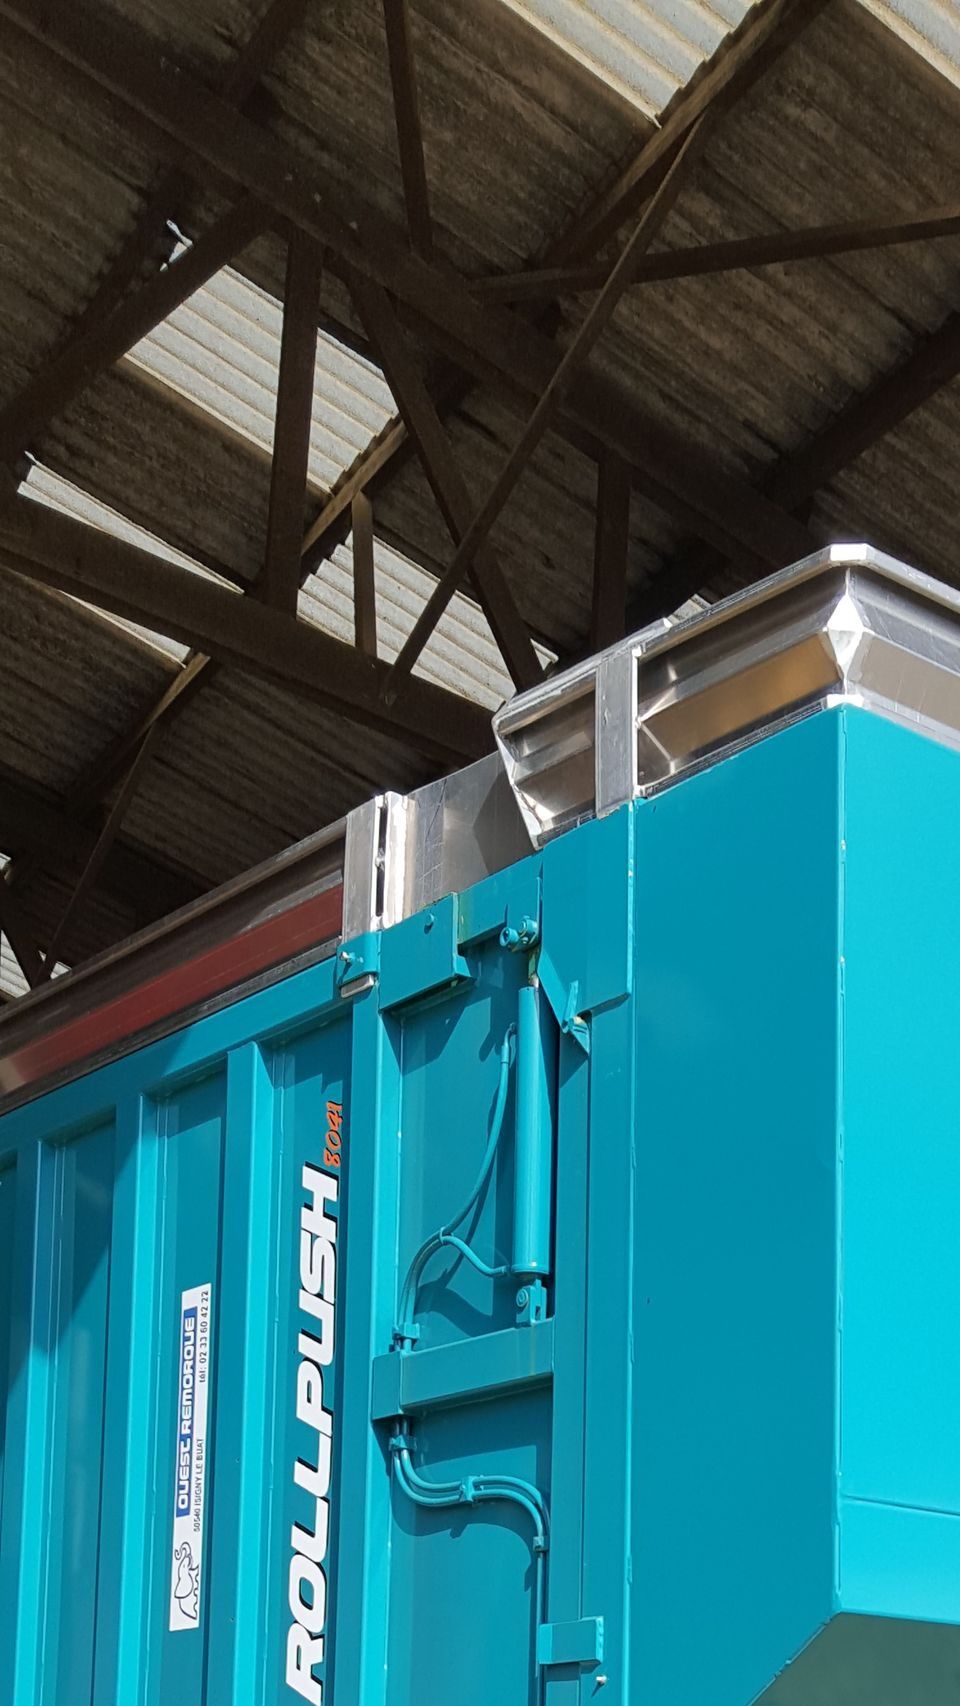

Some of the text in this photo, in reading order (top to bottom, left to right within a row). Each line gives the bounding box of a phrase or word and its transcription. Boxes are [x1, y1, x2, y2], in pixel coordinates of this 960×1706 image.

[323, 1100, 343, 1168] 8041
[200, 1291, 209, 1303] 22
[200, 1306, 209, 1318] 42
[199, 1321, 208, 1333] 60
[199, 1336, 208, 1348] 33
[199, 1352, 207, 1364] 02
[177, 1316, 196, 1510] OUEST REMORQUE
